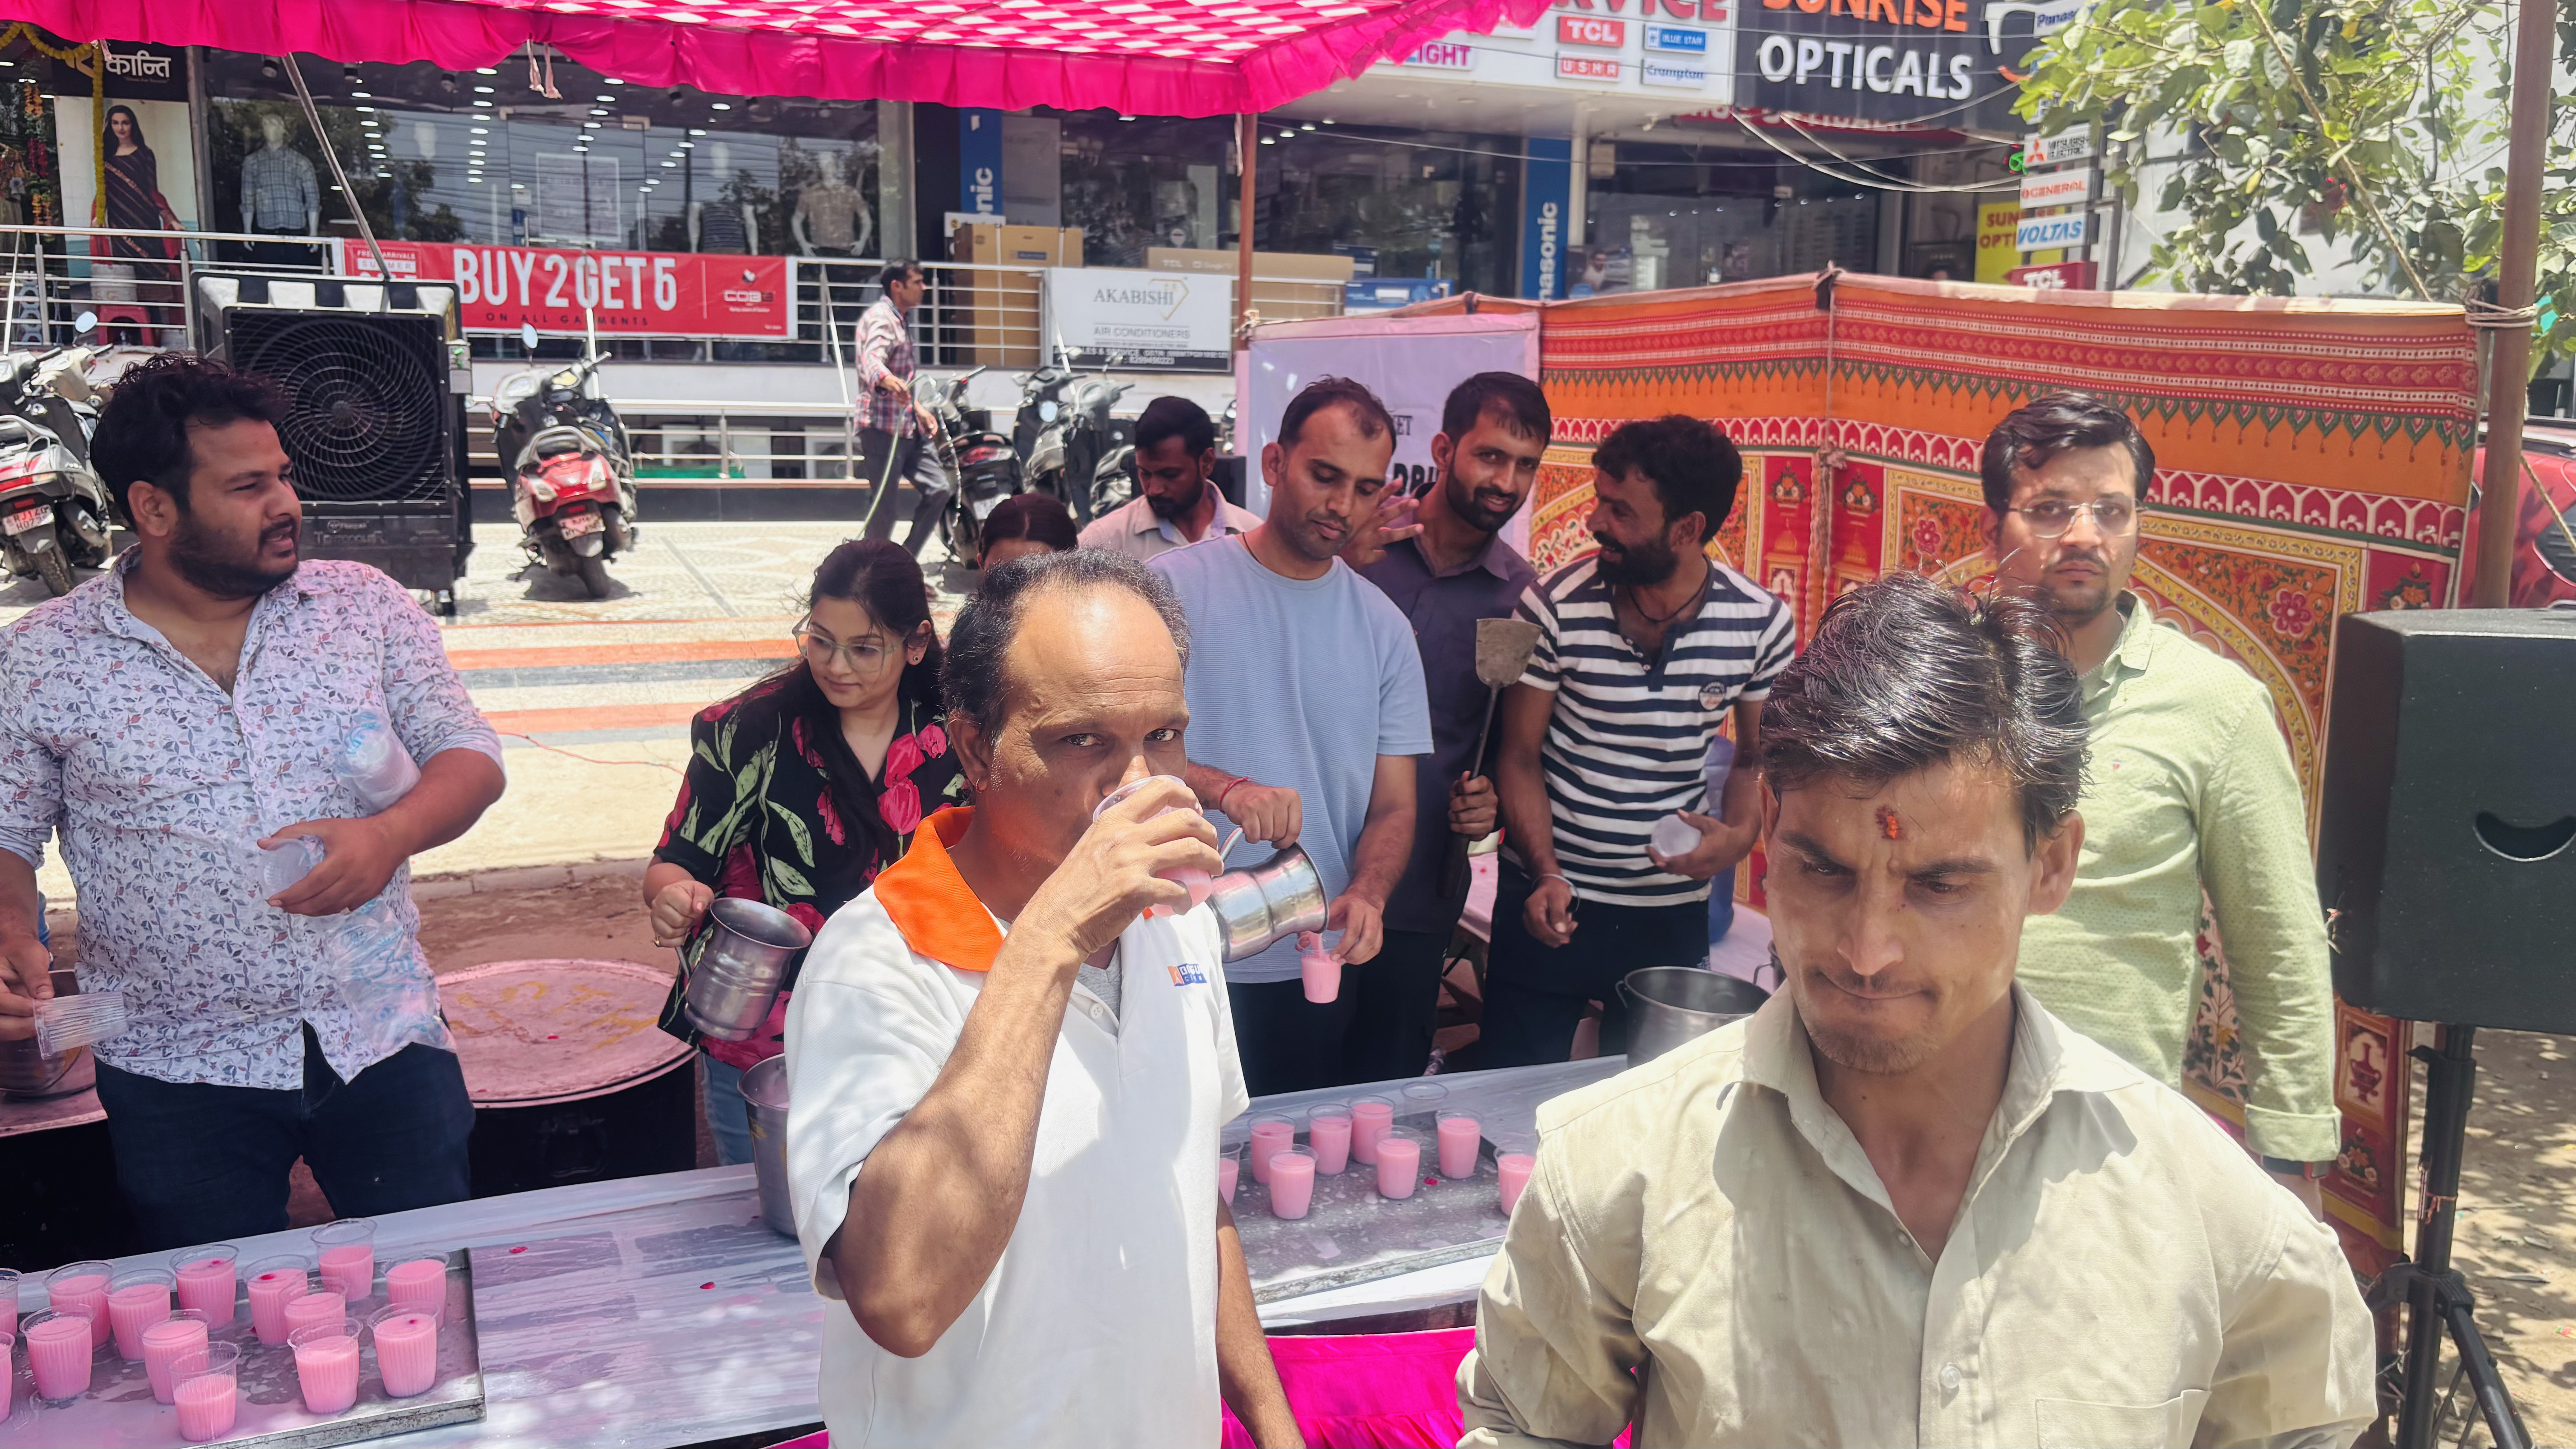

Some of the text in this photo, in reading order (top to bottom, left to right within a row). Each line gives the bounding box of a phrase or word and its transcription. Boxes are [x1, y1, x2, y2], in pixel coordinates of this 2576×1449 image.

[1567, 19, 1618, 43] TCL
[1662, 32, 1703, 45] BLUE STAR
[106, 50, 172, 78] कान्ति
[1758, 35, 1973, 100] OPTICALS
[2017, 221, 2082, 245] VOLTAS
[1538, 202, 1558, 301] nasonic
[362, 261, 410, 269] SUMER
[1094, 289, 1174, 305] AKABISHI
[486, 313, 648, 326] ON ALL GAMENTS
[1094, 327, 1191, 339] AIR CONDITIONERS
